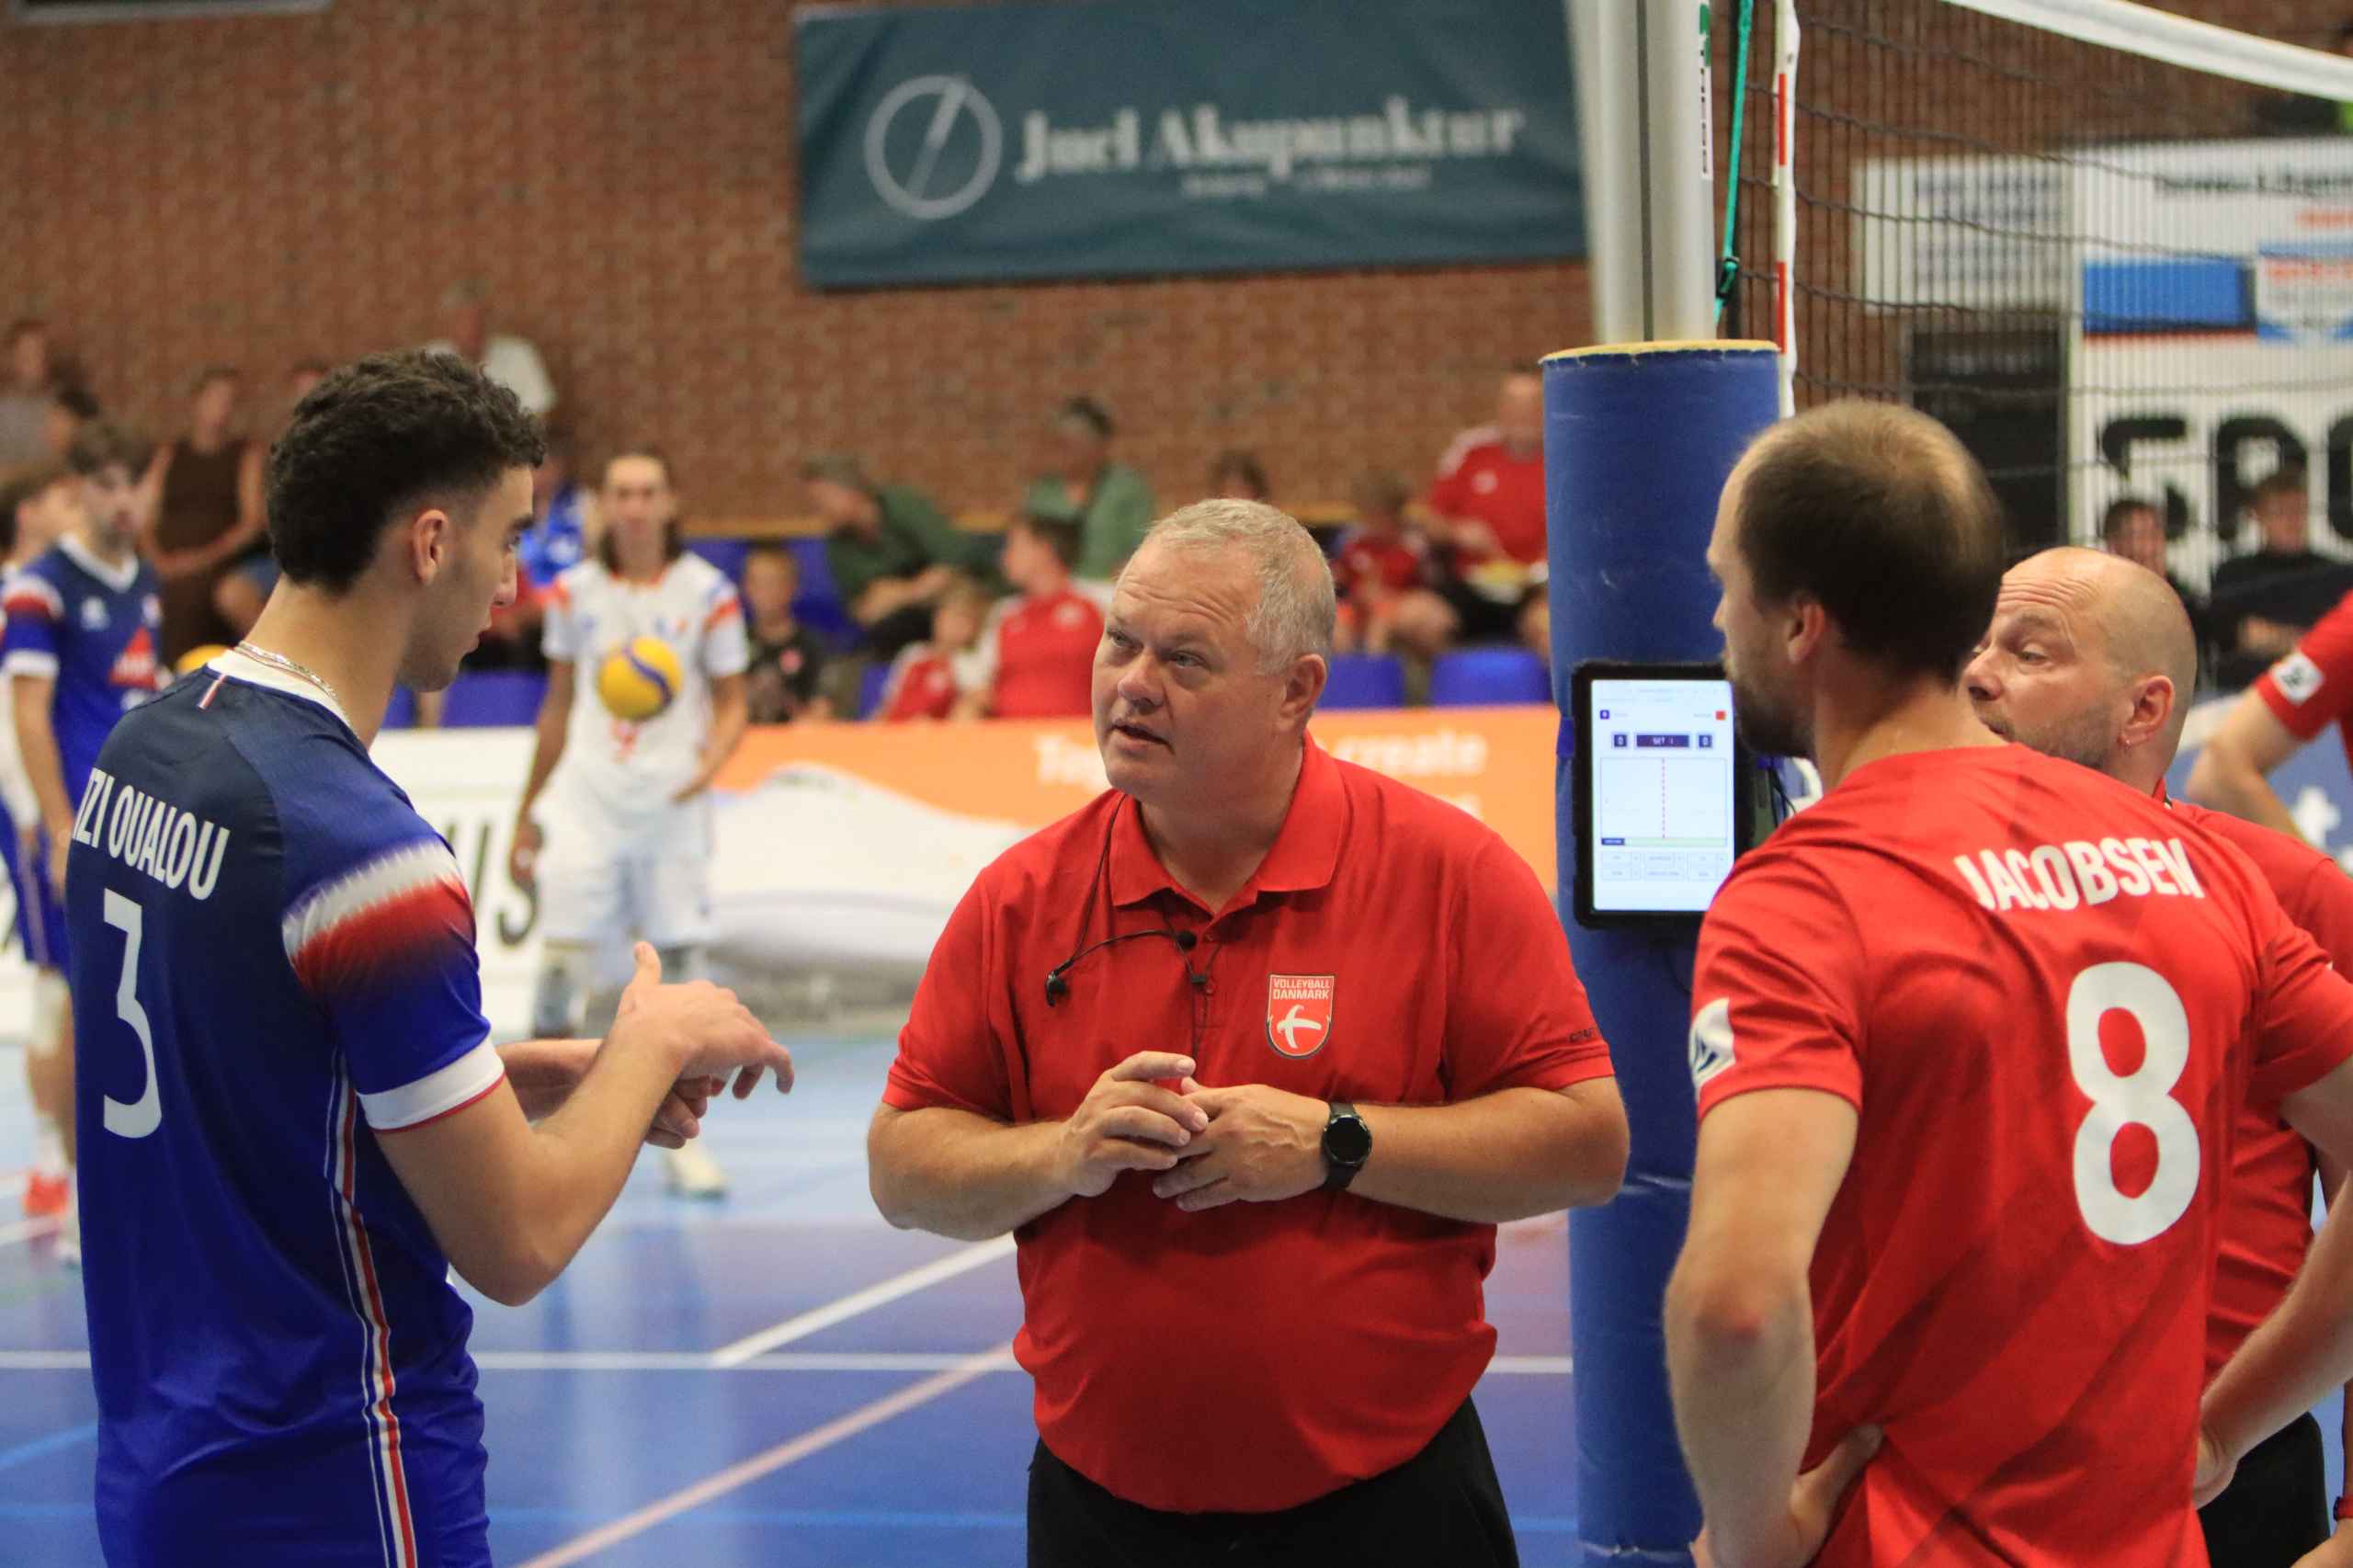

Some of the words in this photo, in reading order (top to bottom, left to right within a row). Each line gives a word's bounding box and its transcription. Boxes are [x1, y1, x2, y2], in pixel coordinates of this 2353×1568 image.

[108, 785, 231, 901] OUALOU
[1953, 837, 2205, 911] JACOBSEN
[104, 888, 163, 1139] 3
[1272, 989, 1329, 1000] DANMARK
[1273, 978, 1330, 989] VOLLEYBALL
[2065, 960, 2200, 1244] 8
